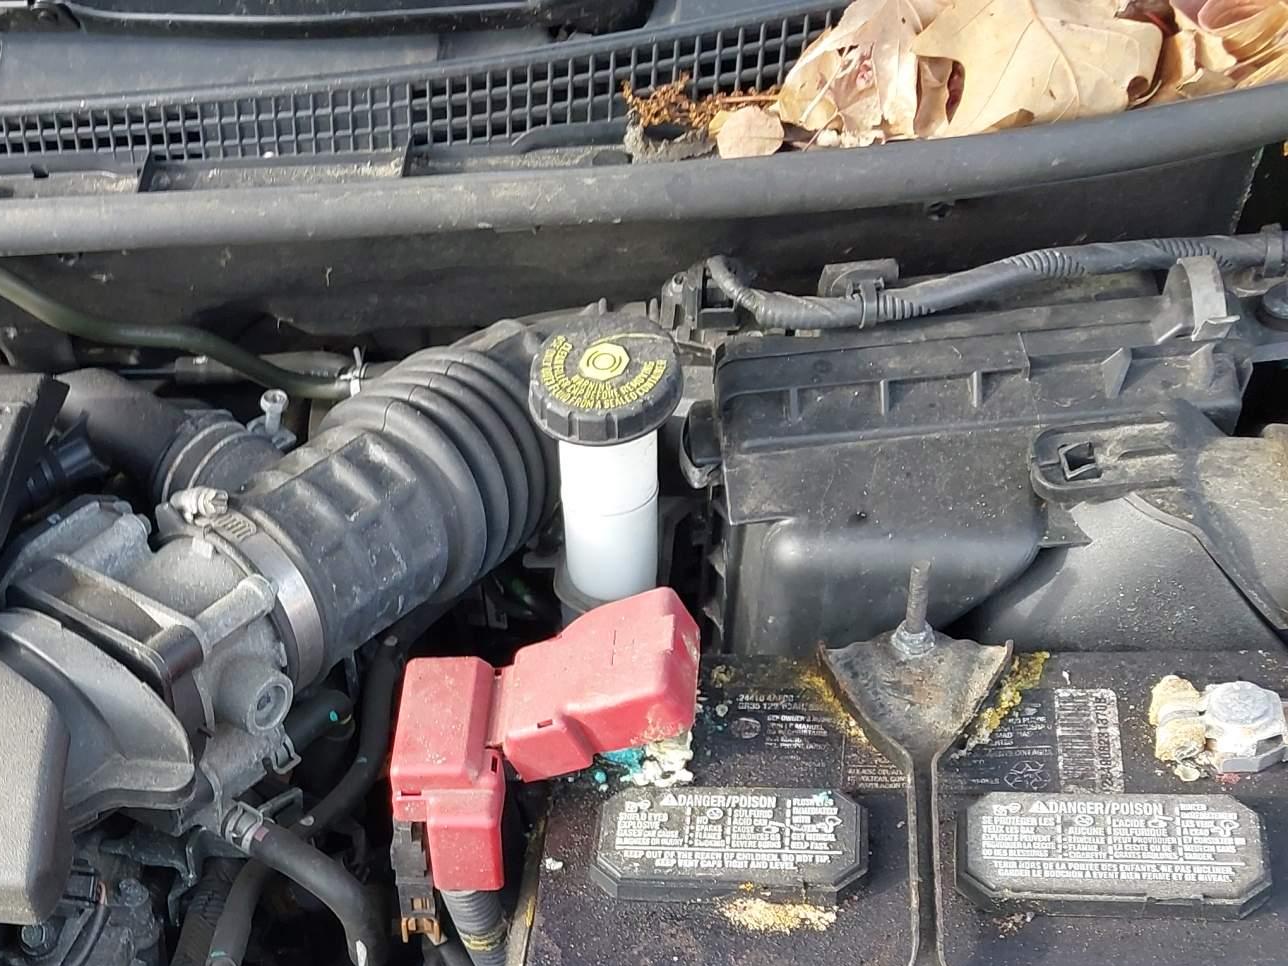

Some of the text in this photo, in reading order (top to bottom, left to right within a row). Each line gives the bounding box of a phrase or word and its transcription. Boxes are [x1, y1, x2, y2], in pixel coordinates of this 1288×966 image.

[677, 794, 777, 808] DANGER/POISON
[1048, 801, 1164, 816] DANGER/POISON
[617, 820, 661, 830] EXPLOSIVE
[732, 818, 752, 827] ACID
[1068, 826, 1105, 836] AUCUNE
